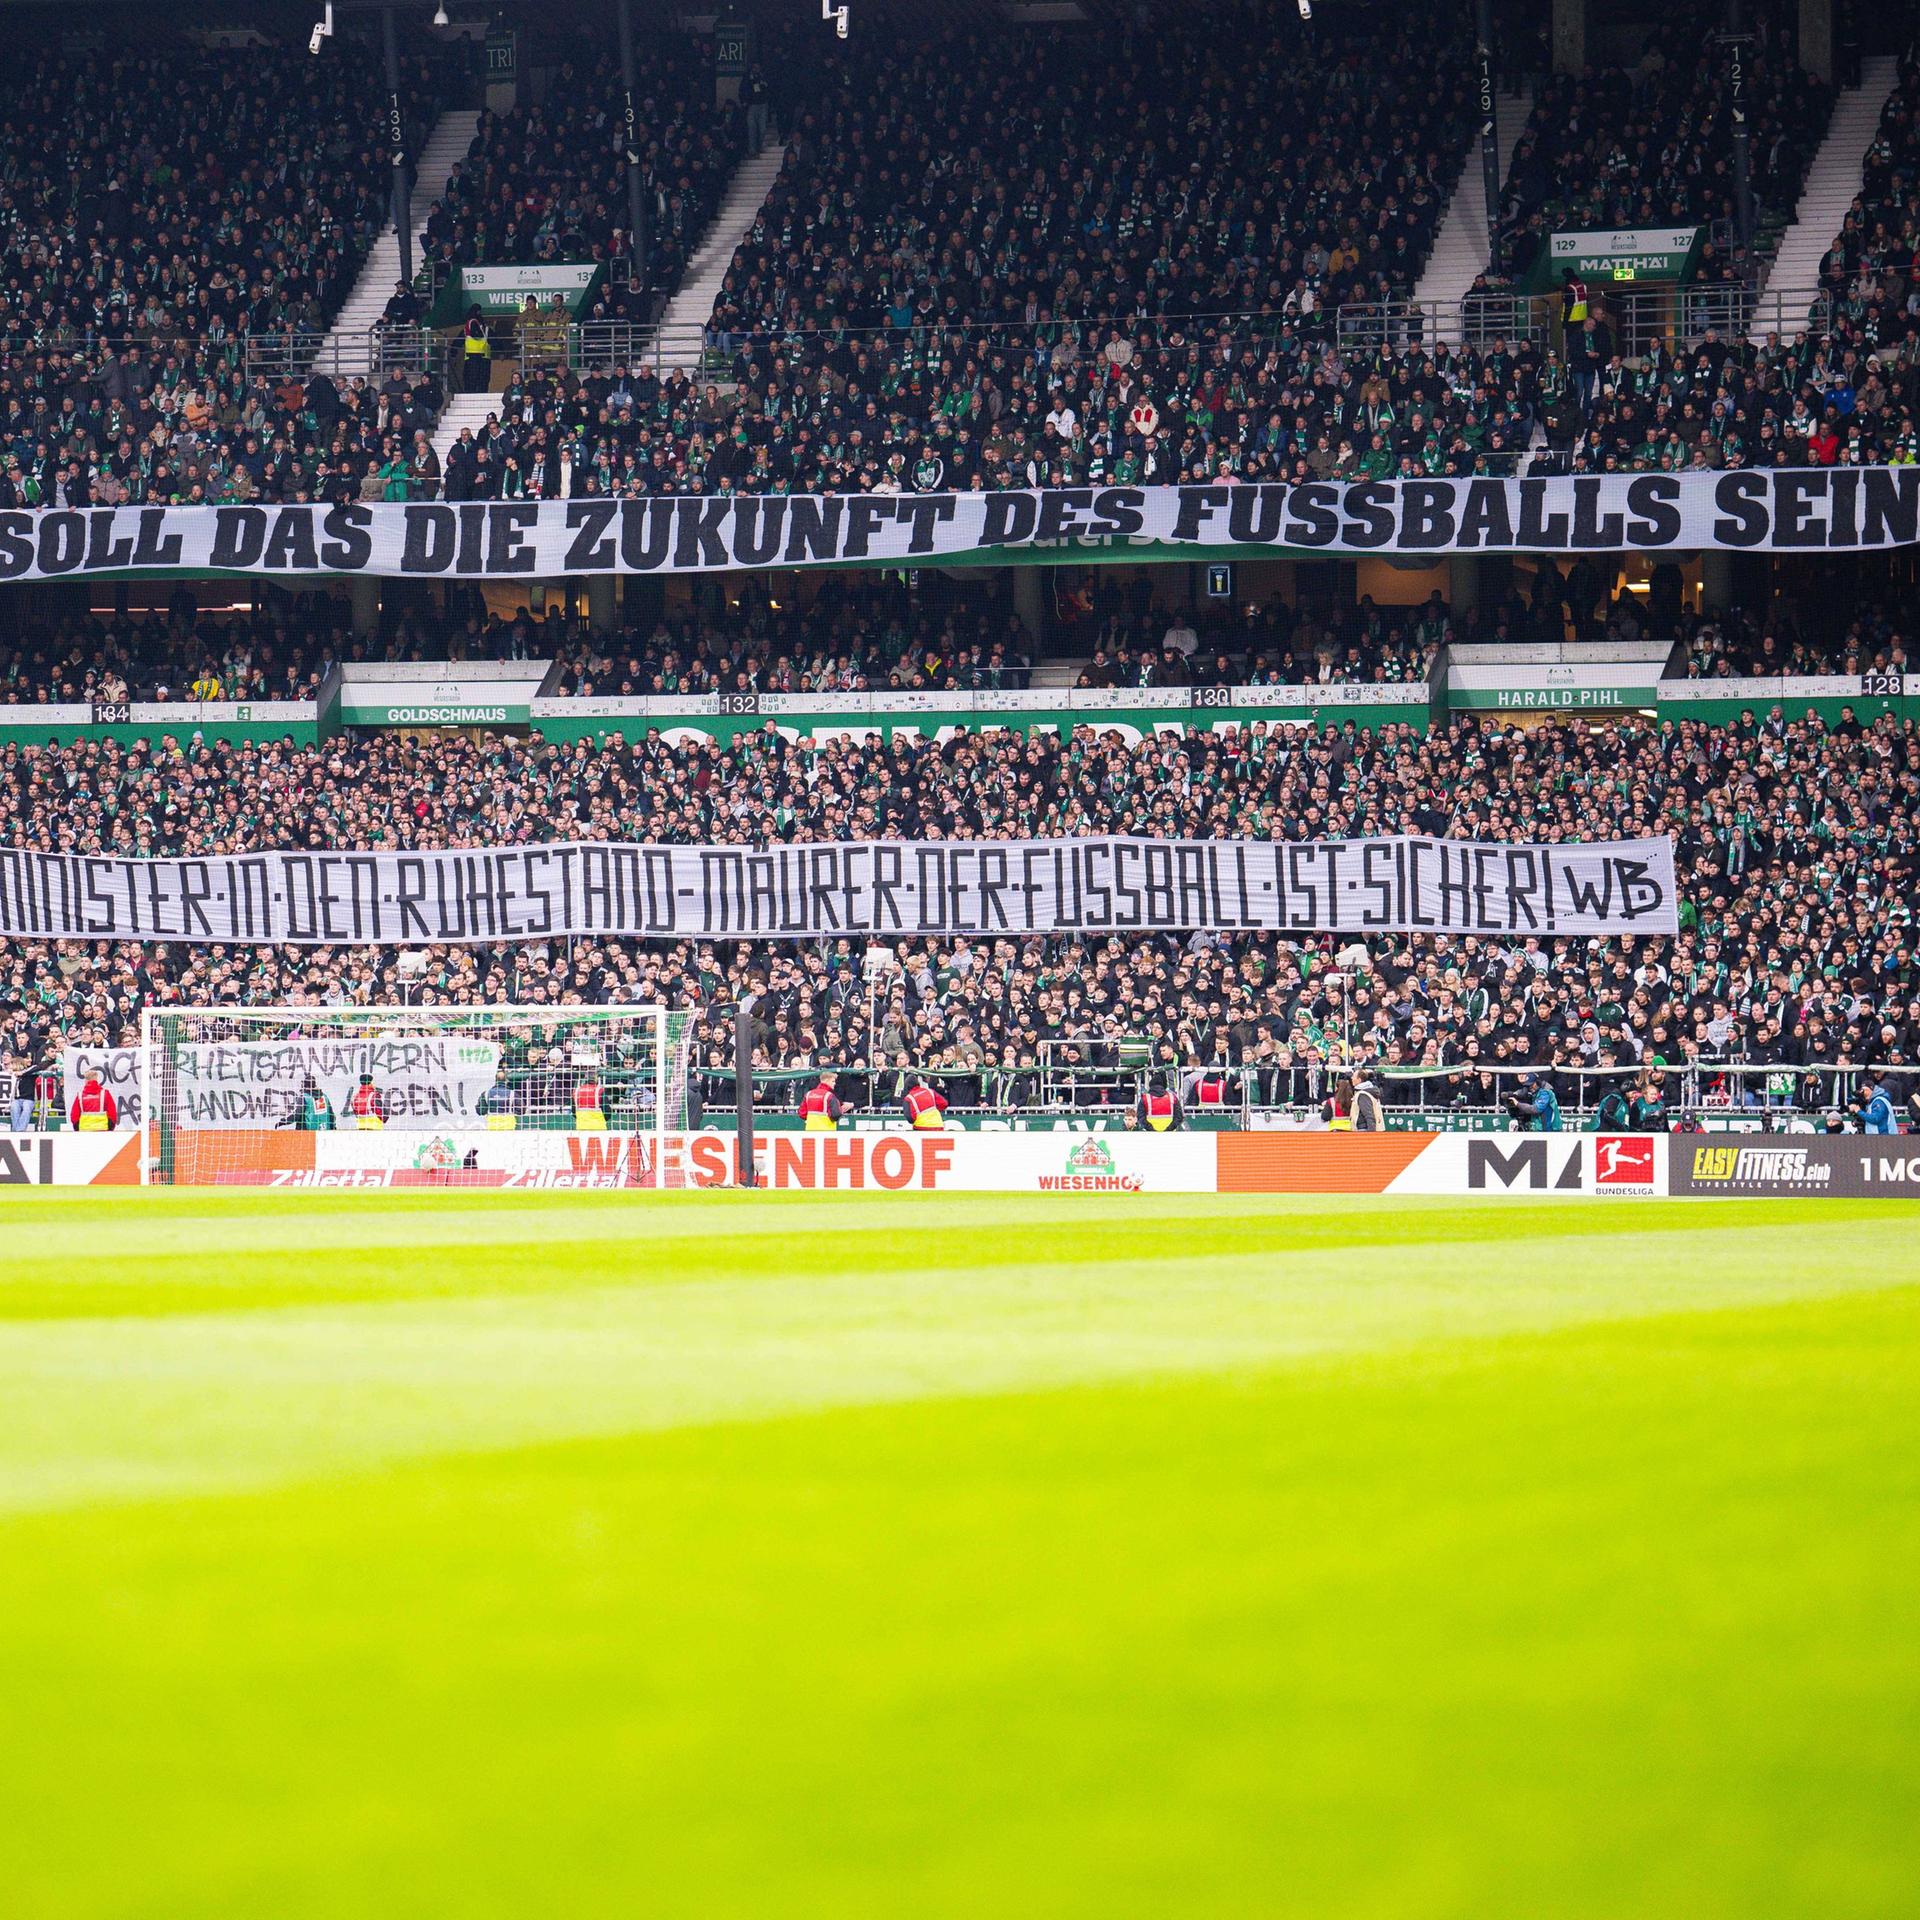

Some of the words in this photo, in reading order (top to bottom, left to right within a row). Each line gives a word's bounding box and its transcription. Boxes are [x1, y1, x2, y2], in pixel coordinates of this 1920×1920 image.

[717, 42, 743, 62] ARI
[1555, 240, 1576, 251] 129
[1672, 236, 1692, 246] 127
[1580, 256, 1668, 272] MATTHÄI
[465, 274, 485, 285] 133
[0, 508, 182, 577] SOLL
[209, 506, 373, 569] DAS
[400, 503, 538, 574] DIE
[564, 494, 956, 570] ZUKUNFT
[977, 488, 1144, 547] DES
[1171, 475, 1682, 548] FUSSBALLS
[1714, 468, 1920, 547] SEIN
[1864, 676, 1901, 695] 128
[722, 696, 756, 713] 132
[1498, 692, 1572, 706] HARALD
[1580, 690, 1623, 704] PIHL
[387, 708, 507, 722] GOLDSCHMAUS
[1860, 1157, 1872, 1182] 1
[269, 1169, 393, 1187] Zillertal
[1038, 1175, 1134, 1190] WIESENHO
